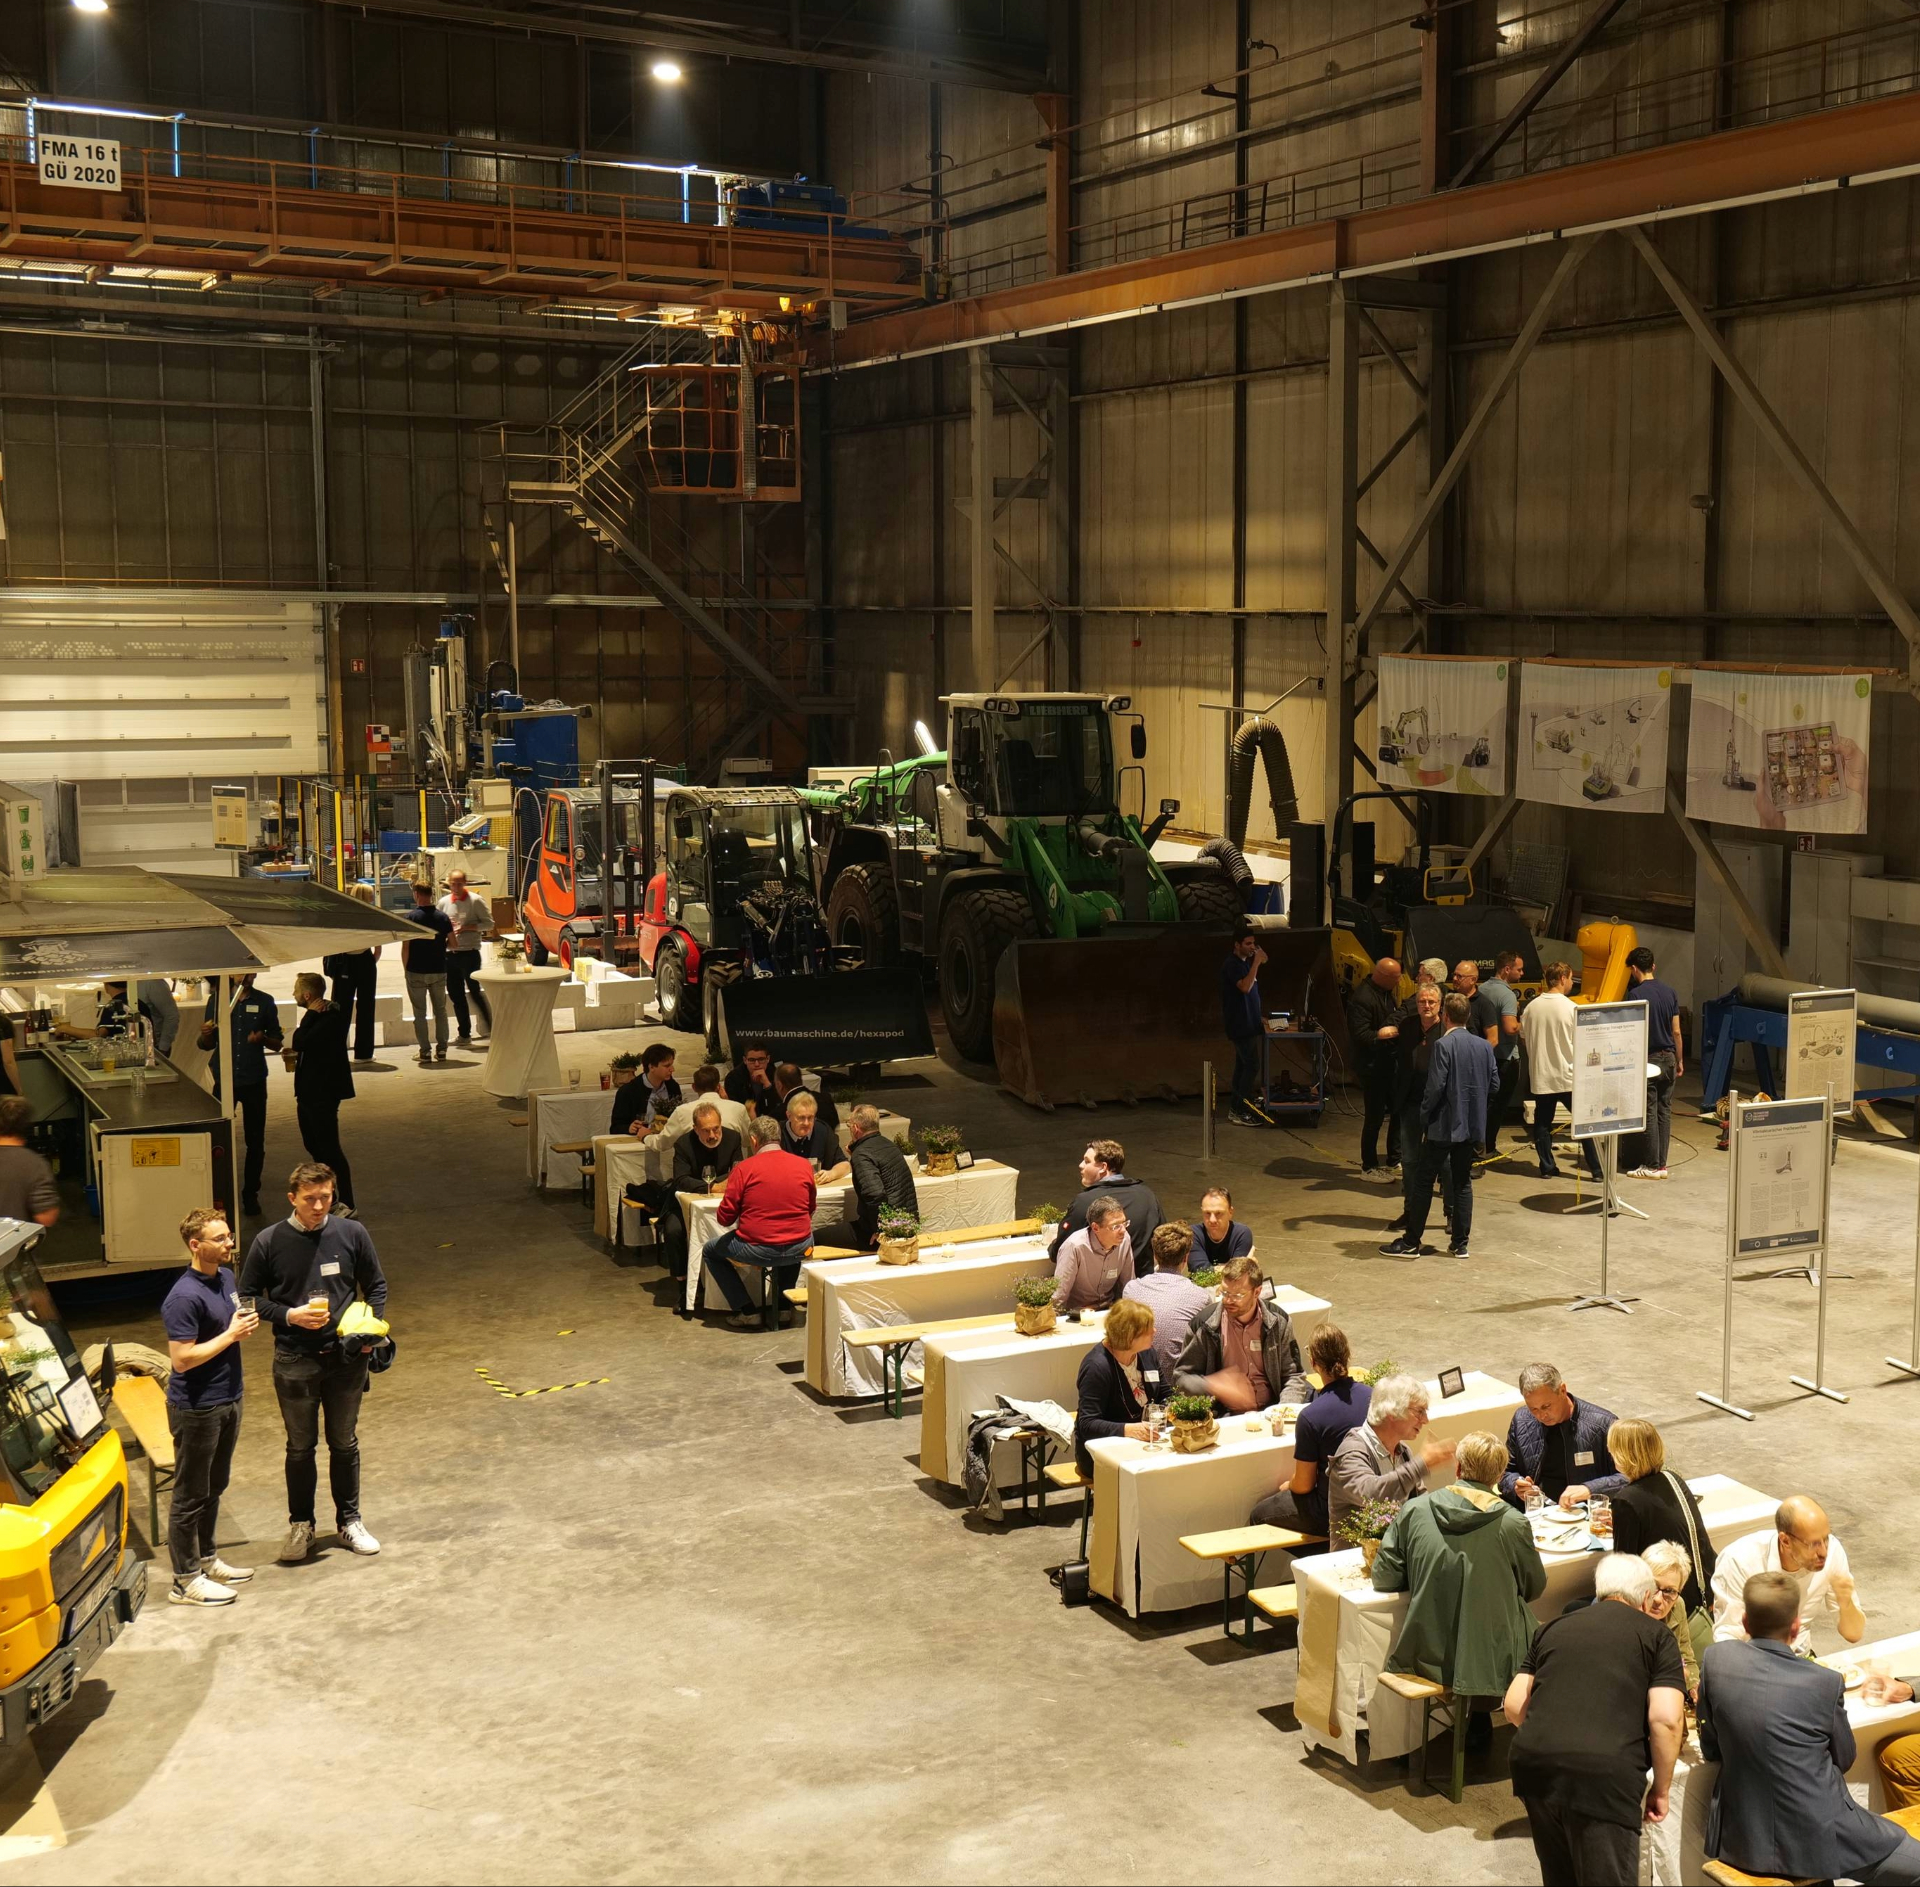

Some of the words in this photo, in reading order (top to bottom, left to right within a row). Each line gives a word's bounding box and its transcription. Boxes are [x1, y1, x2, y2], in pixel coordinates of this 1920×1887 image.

[42, 141, 78, 158] FMA
[85, 145, 105, 160] 16
[111, 148, 117, 162] t
[45, 161, 67, 179] GÜ
[74, 166, 116, 184] 2020
[1029, 706, 1089, 716] LIEBHERR
[735, 1028, 905, 1039] www.baumaschine.de/hexapod
